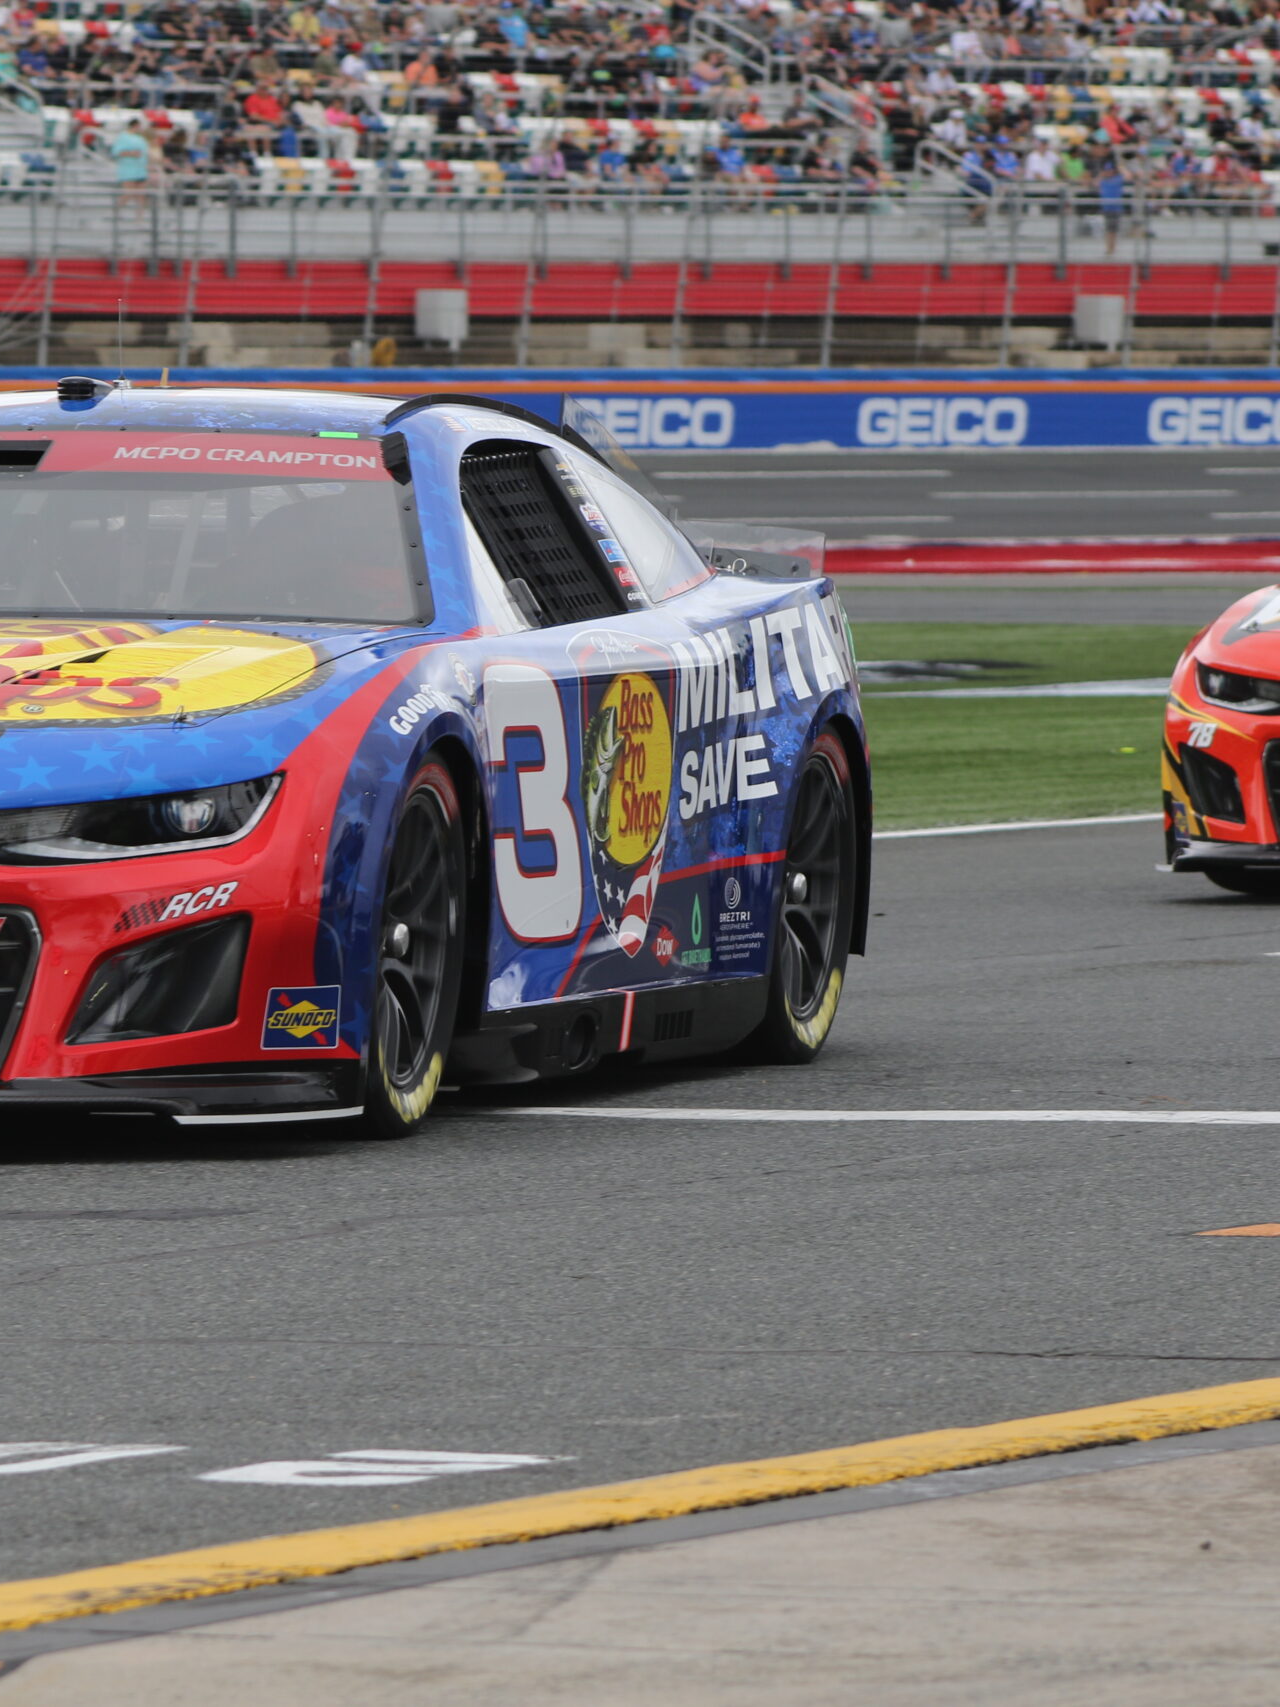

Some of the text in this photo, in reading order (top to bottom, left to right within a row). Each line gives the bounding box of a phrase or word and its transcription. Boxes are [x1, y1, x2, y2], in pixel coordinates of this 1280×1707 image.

[573, 398, 734, 446] GEICO
[857, 397, 1029, 446] GEICO
[1147, 397, 1280, 443] GEIC
[114, 446, 376, 469] MCPO CRAMPTON
[618, 679, 654, 732] Bass
[618, 731, 646, 783] Pro
[1187, 722, 1218, 748] 78
[679, 734, 779, 820] SAVE
[482, 661, 583, 943] 3
[618, 780, 662, 846] Shops
[159, 881, 239, 922] RCR
[270, 1010, 335, 1027] SUNOCO
